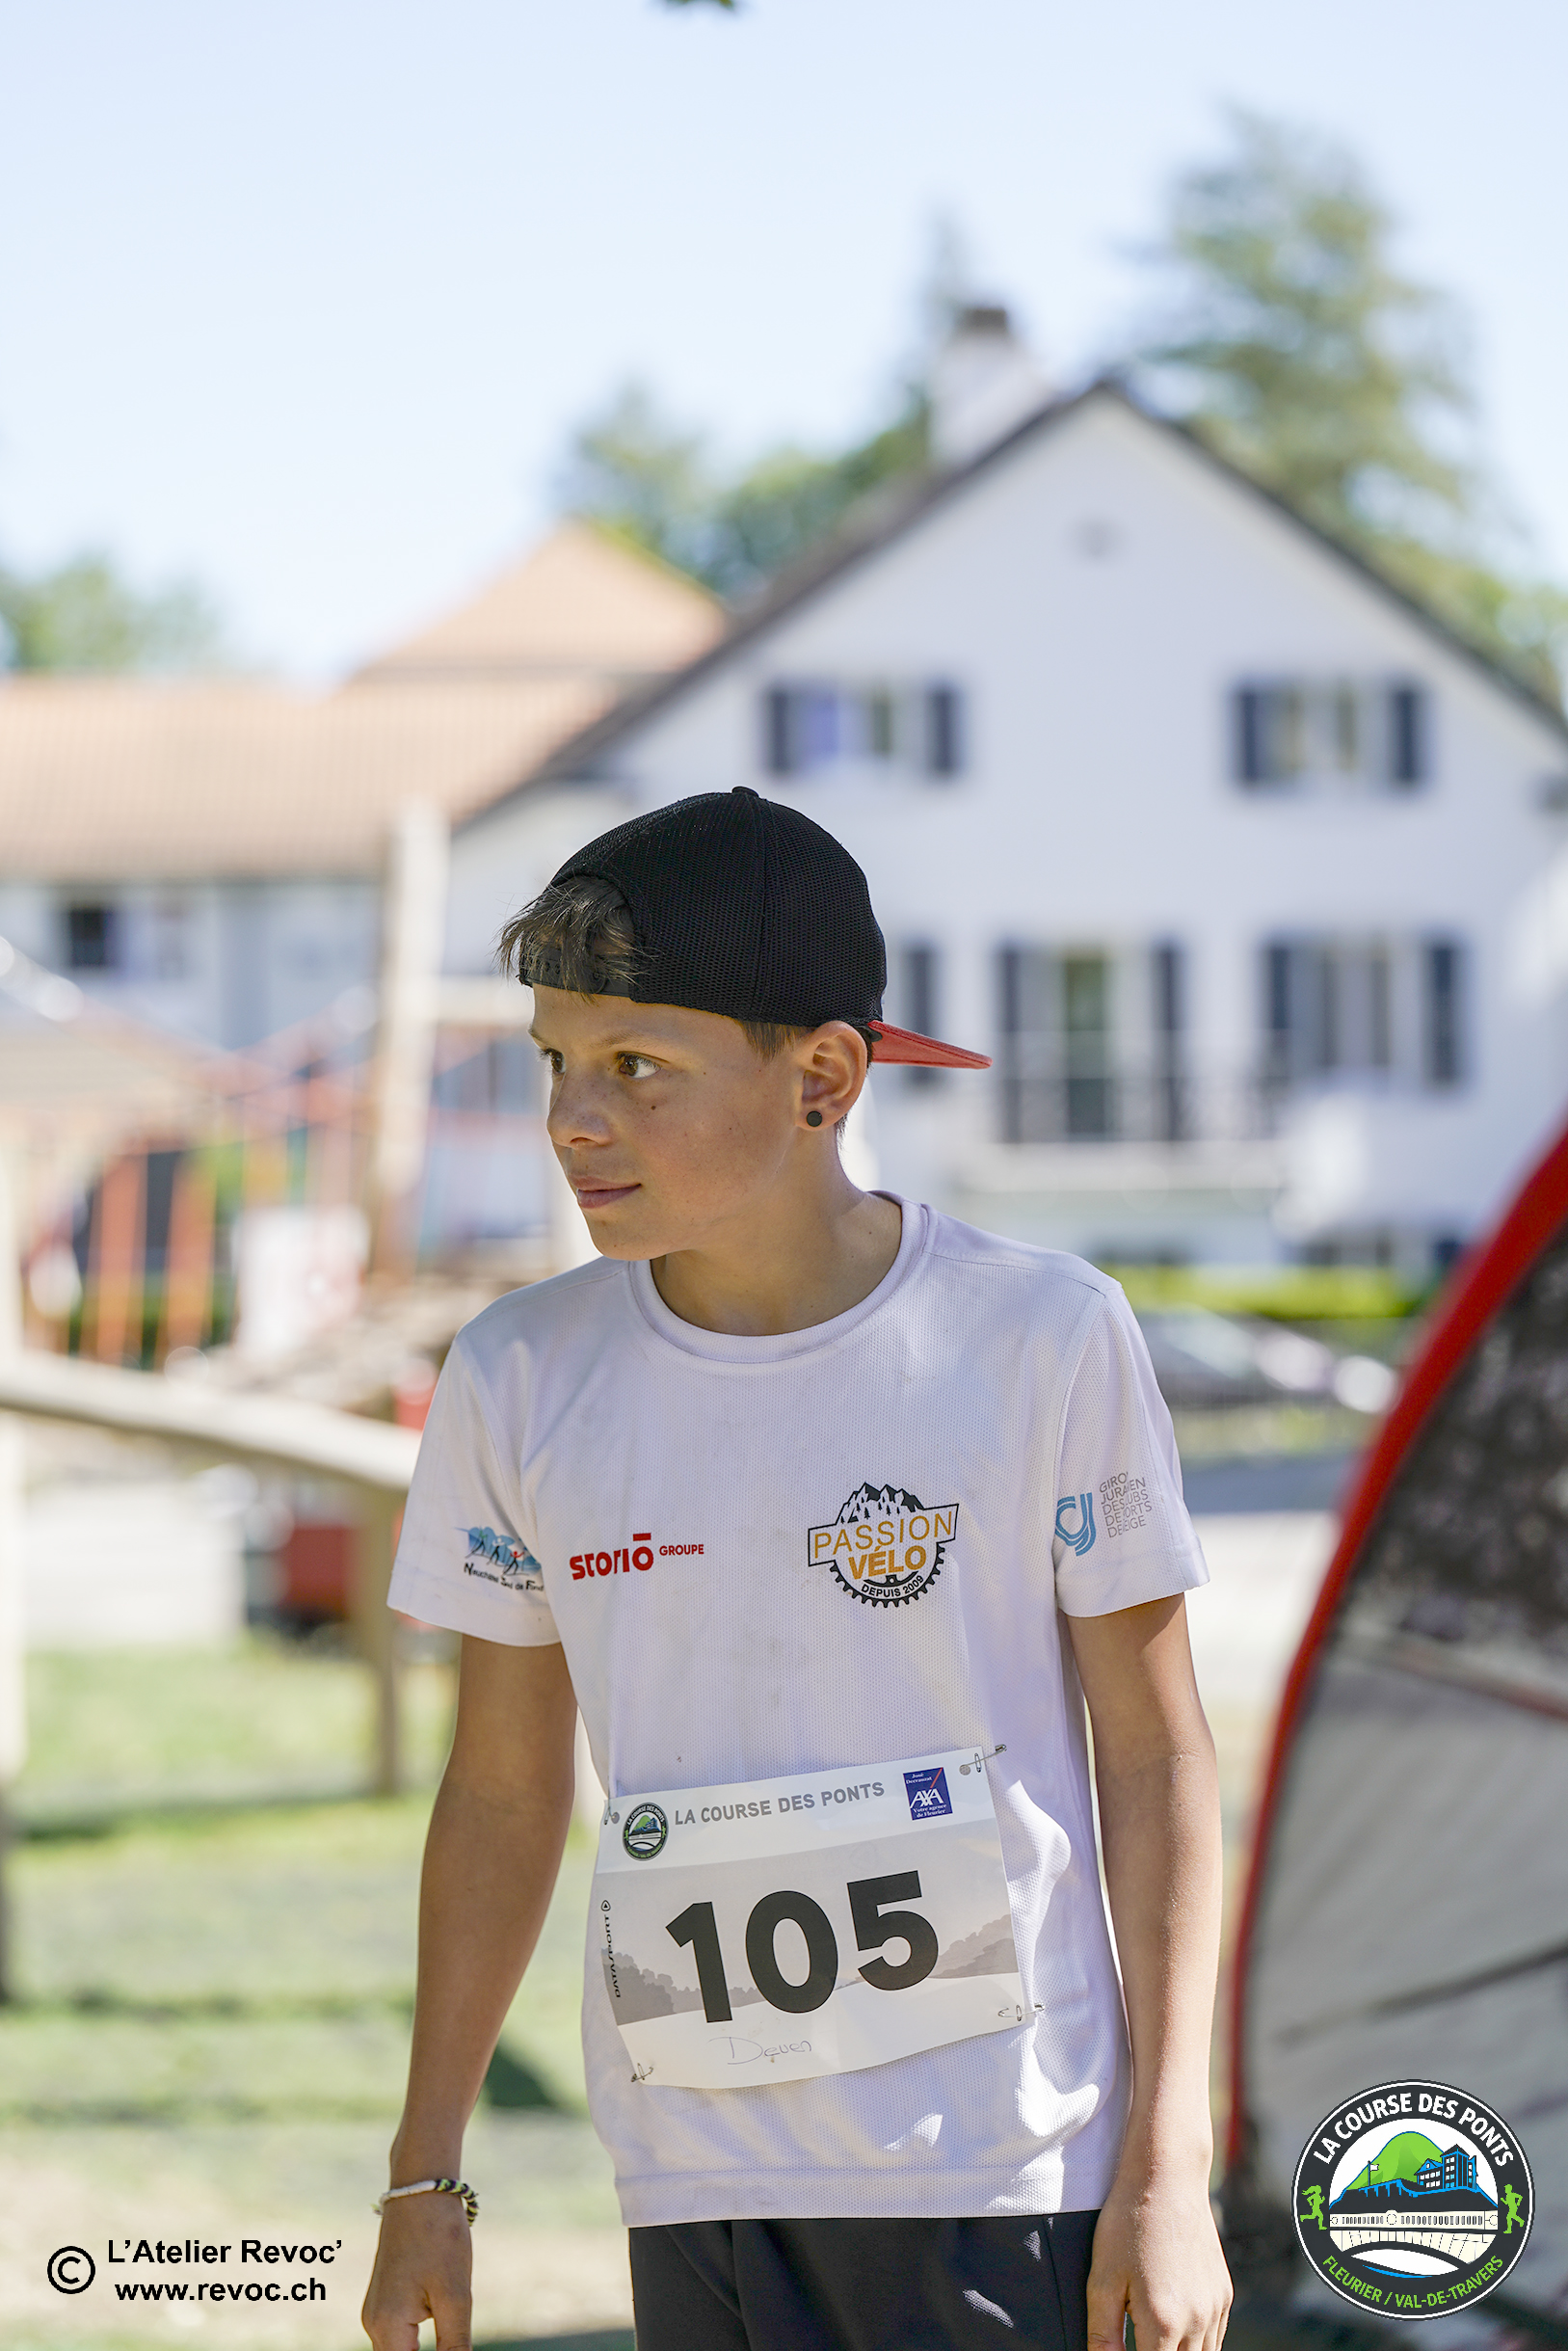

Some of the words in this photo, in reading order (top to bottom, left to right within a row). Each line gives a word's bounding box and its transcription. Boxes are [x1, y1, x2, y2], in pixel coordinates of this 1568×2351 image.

[1100, 1471, 1129, 1493] GIRO
[814, 1510, 952, 1559] PASSION
[659, 1544, 704, 1556] GROUPE
[848, 1545, 927, 1580] VÉLO
[861, 1584, 901, 1598] DEPUIS
[902, 1575, 924, 1595] 2009
[675, 1808, 696, 1826] LA
[701, 1800, 772, 1823] COURSE
[778, 1793, 815, 1813] DES
[820, 1781, 885, 1806] PONTS
[910, 1788, 943, 1808] AXA
[665, 1870, 939, 2023] 105
